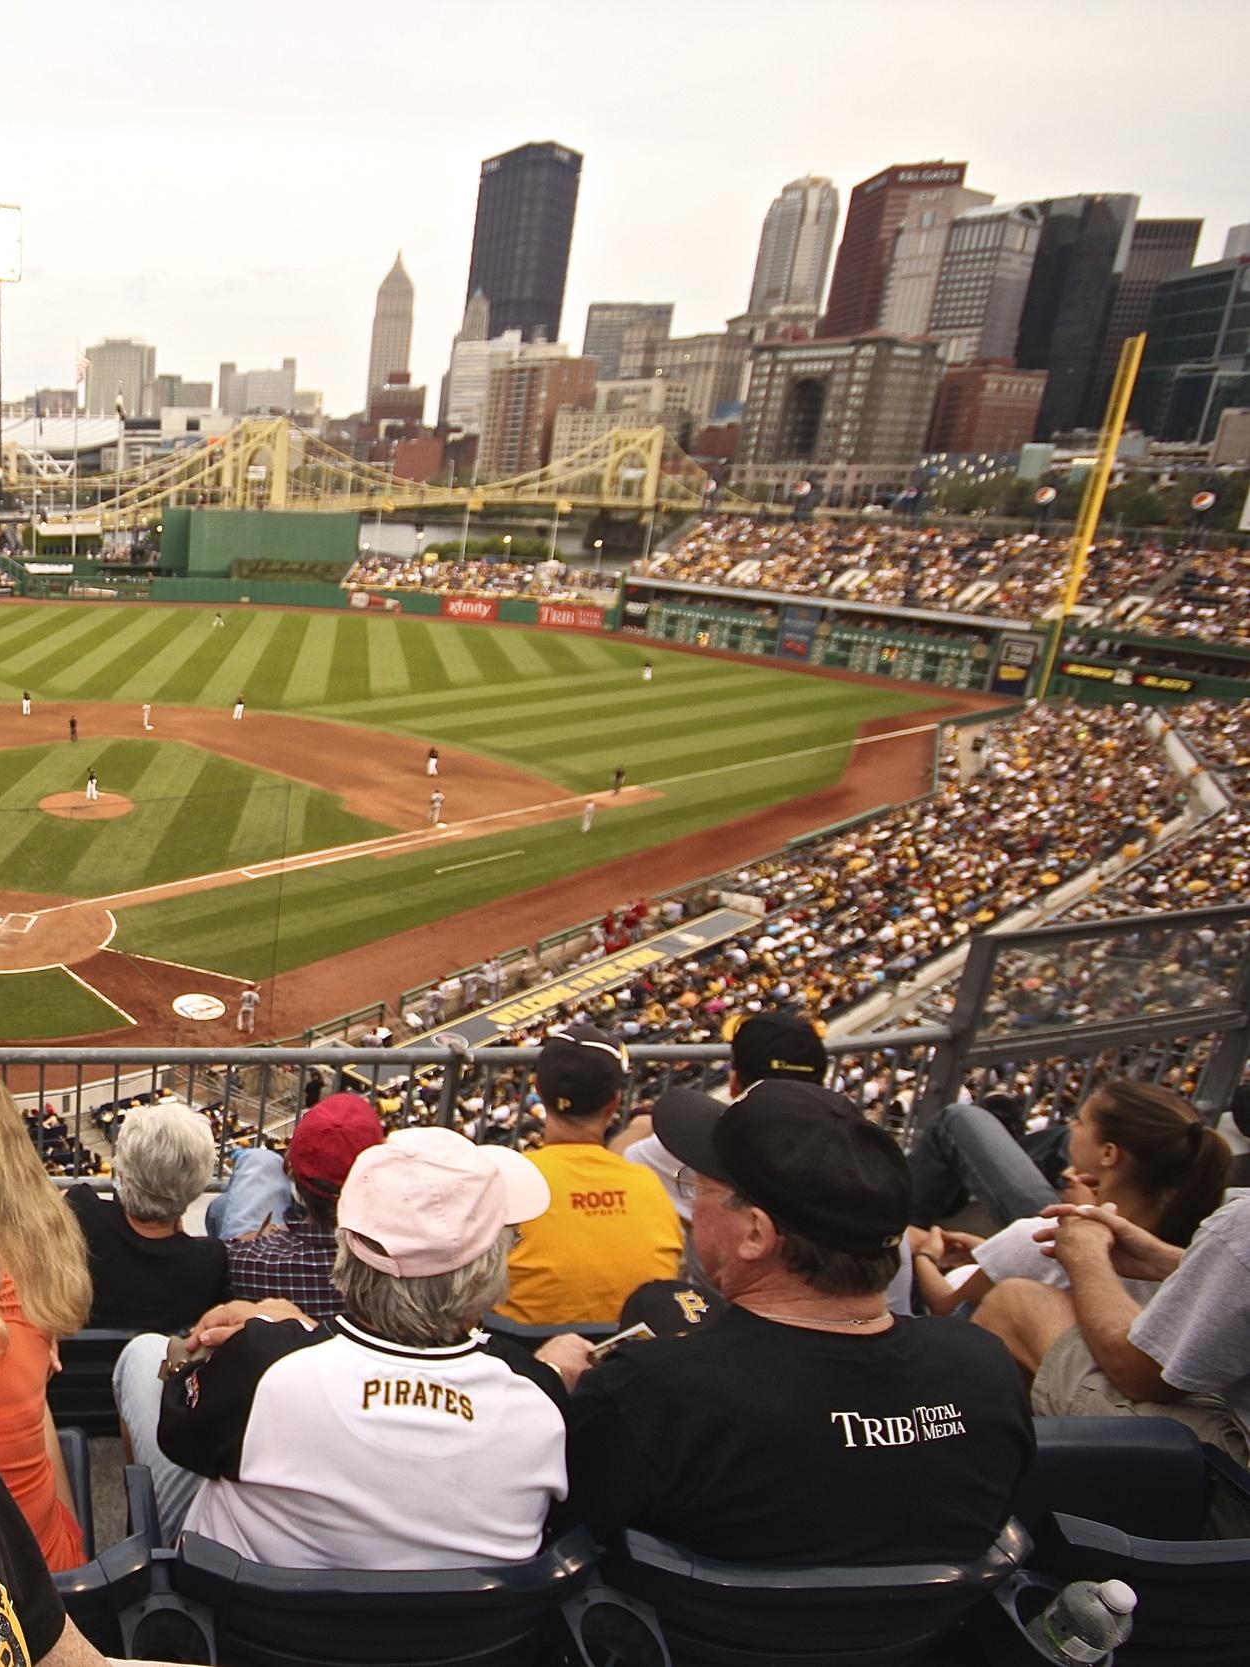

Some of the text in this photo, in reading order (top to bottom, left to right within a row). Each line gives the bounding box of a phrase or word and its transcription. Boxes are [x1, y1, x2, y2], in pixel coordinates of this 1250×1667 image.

[448, 599, 492, 618] xfinity
[662, 607, 715, 620] NATIONAL
[831, 631, 970, 657] AMERICAN LEAGUE
[570, 1190, 628, 1211] ROOT
[673, 1289, 711, 1324] P
[362, 1378, 475, 1422] PIRATES
[916, 1403, 962, 1424] TOTAL
[831, 1412, 916, 1448] TRIB
[922, 1420, 967, 1441] MEDIA
